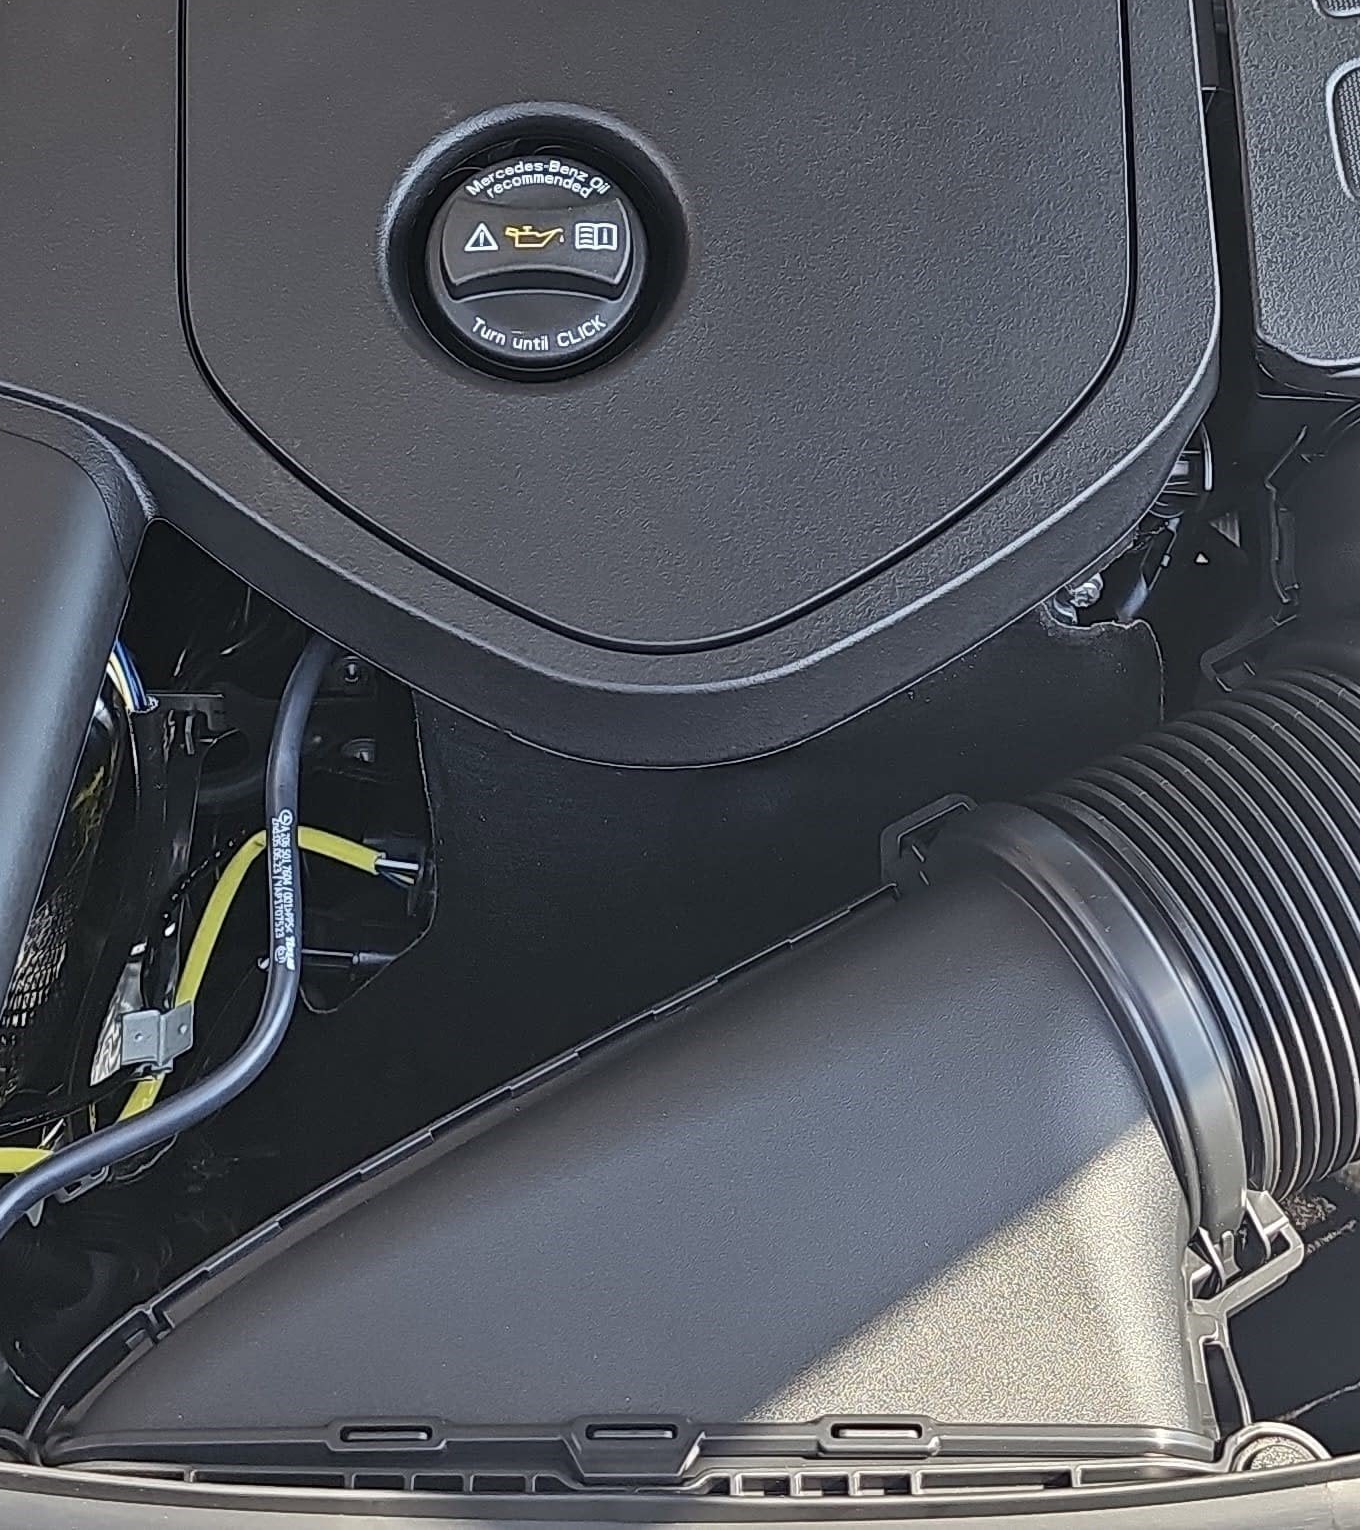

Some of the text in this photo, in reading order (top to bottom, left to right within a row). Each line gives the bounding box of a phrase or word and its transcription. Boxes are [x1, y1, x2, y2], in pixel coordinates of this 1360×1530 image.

[465, 159, 611, 196] Mercedes-Benz Oil
[486, 173, 593, 199] recommended
[472, 314, 607, 351] Turn until CLICK
